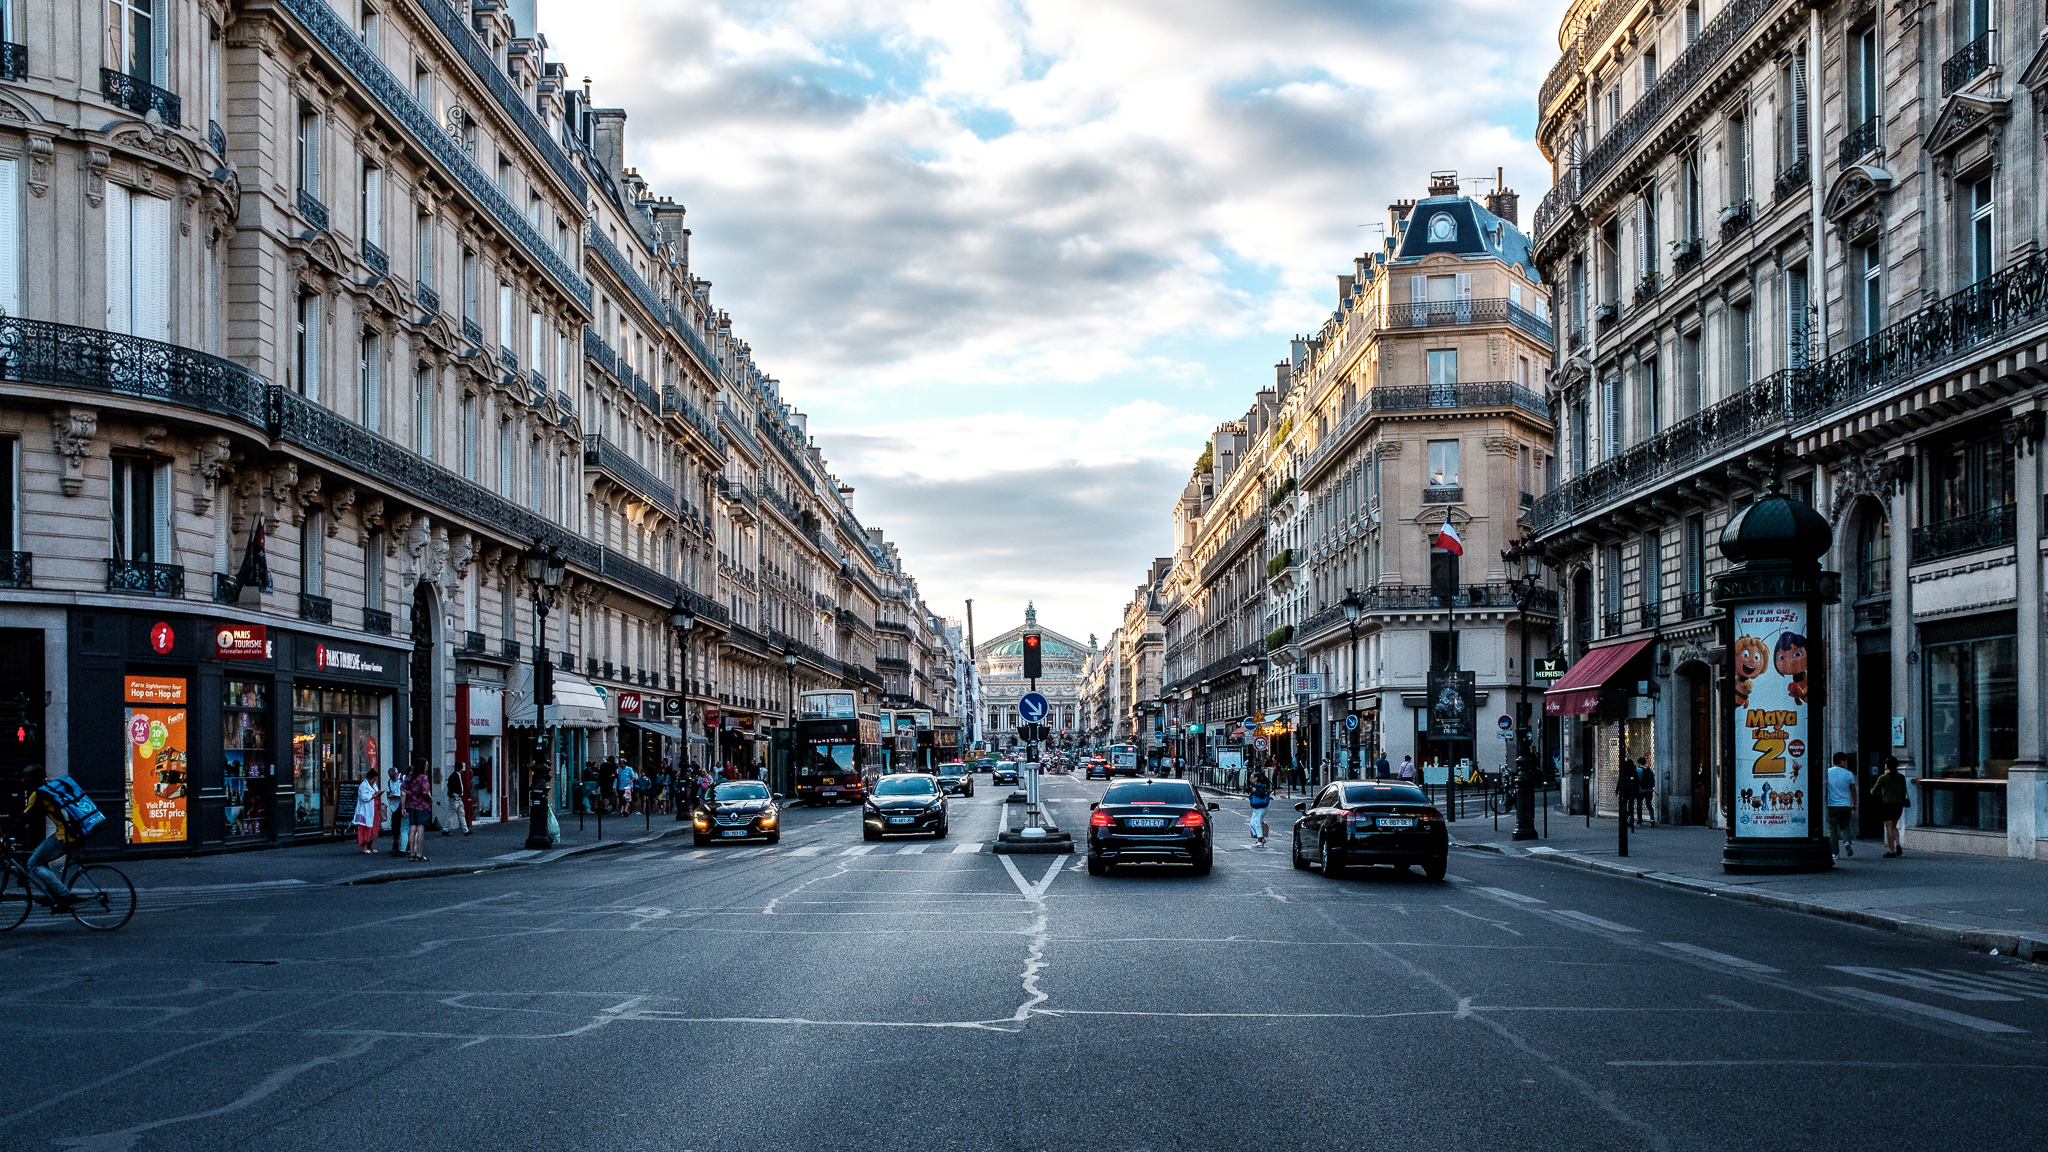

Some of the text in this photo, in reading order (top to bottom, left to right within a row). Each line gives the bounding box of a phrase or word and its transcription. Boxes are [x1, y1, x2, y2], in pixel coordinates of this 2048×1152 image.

[1724, 580, 1811, 595] SPECTACLE
[233, 630, 251, 639] PARIS
[235, 640, 262, 649] TOURISME
[326, 648, 340, 668] PARIS
[340, 651, 361, 670] TOURISME
[1535, 670, 1565, 678] MEPHISTO
[131, 688, 145, 699] Hop
[158, 689, 171, 700] Hop
[172, 690, 182, 698] off
[621, 695, 639, 712] illy
[1745, 708, 1797, 730] Maya
[1752, 738, 1787, 774] 2
[146, 800, 176, 809] Visit Paris
[151, 809, 167, 818] BEST
[168, 809, 185, 819] price
